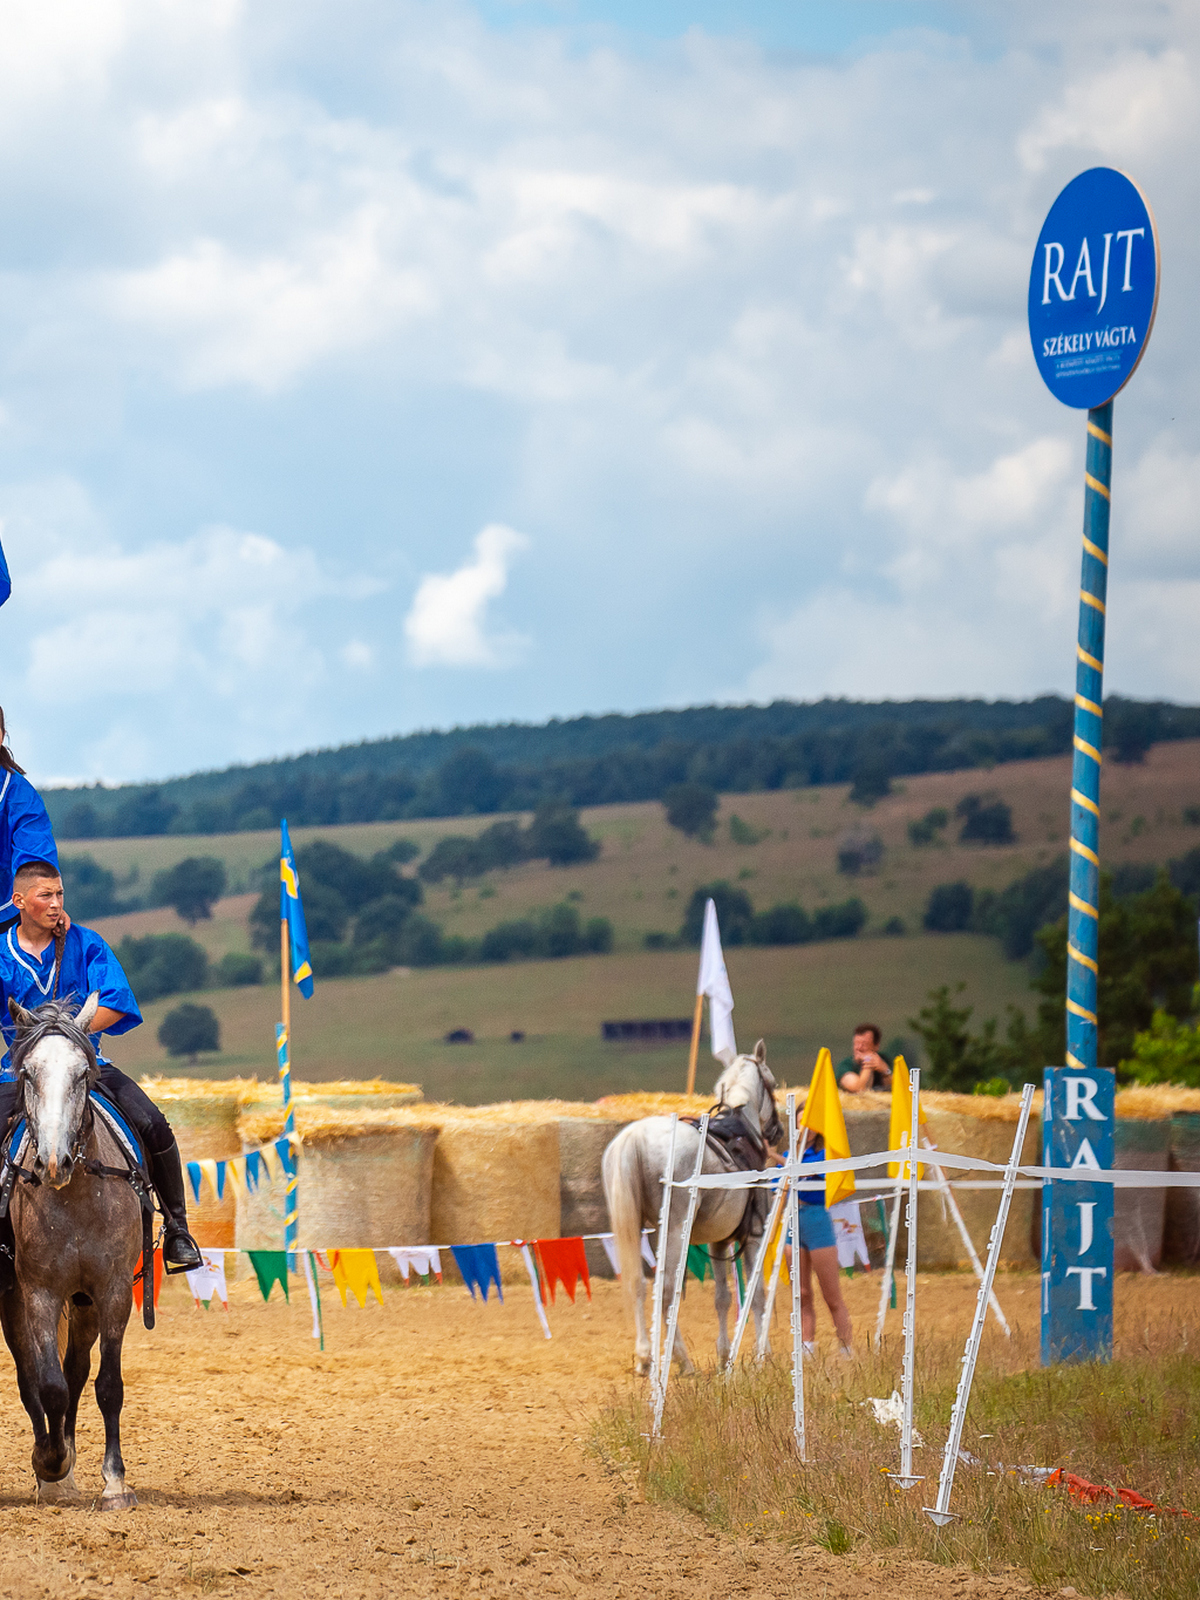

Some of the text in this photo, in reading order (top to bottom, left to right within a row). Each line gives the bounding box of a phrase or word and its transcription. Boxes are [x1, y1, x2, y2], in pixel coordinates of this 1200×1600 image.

[1041, 227, 1145, 315] RAJT
[1042, 325, 1137, 357] SZÉKELY VÁGTA
[1062, 1077, 1109, 1311] RAJT
